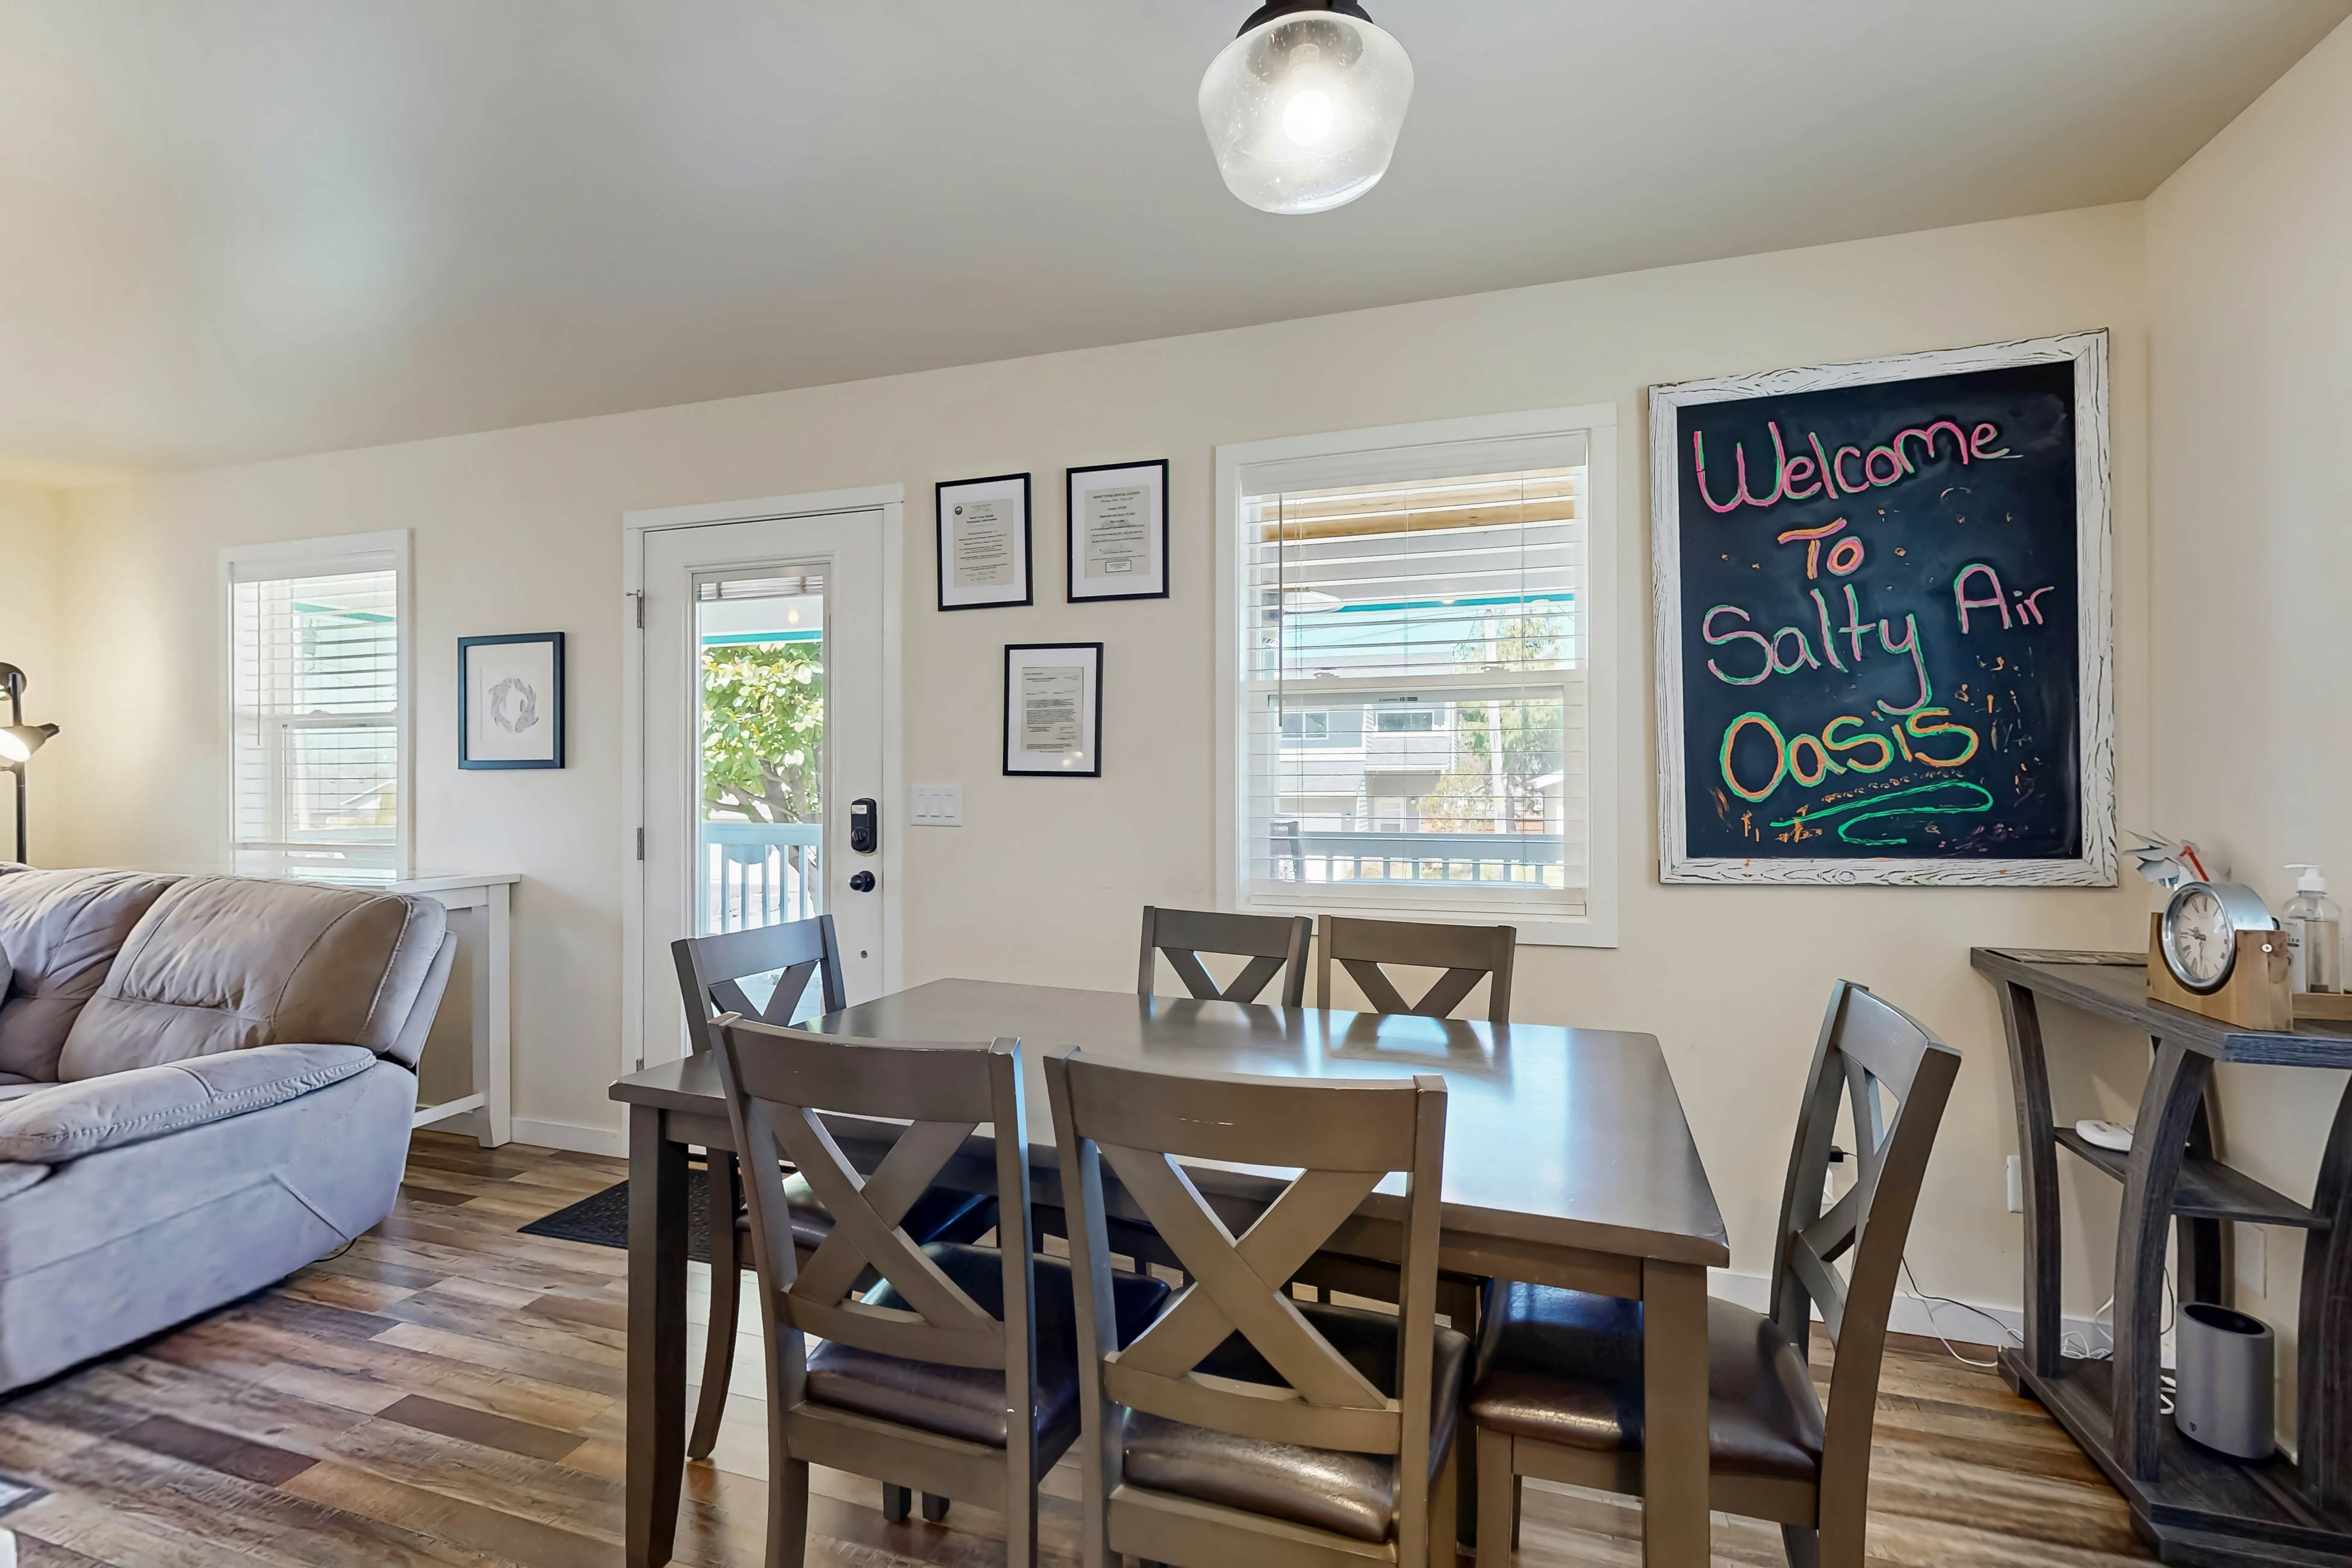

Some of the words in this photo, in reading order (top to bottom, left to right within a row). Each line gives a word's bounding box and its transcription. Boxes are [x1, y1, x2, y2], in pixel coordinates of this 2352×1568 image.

[1693, 421, 2011, 512] Welcome
[1777, 518, 1864, 579] To
[1703, 584, 1932, 715] Salty
[1953, 564, 2055, 634] Air
[1720, 708, 1978, 802] Oasis
